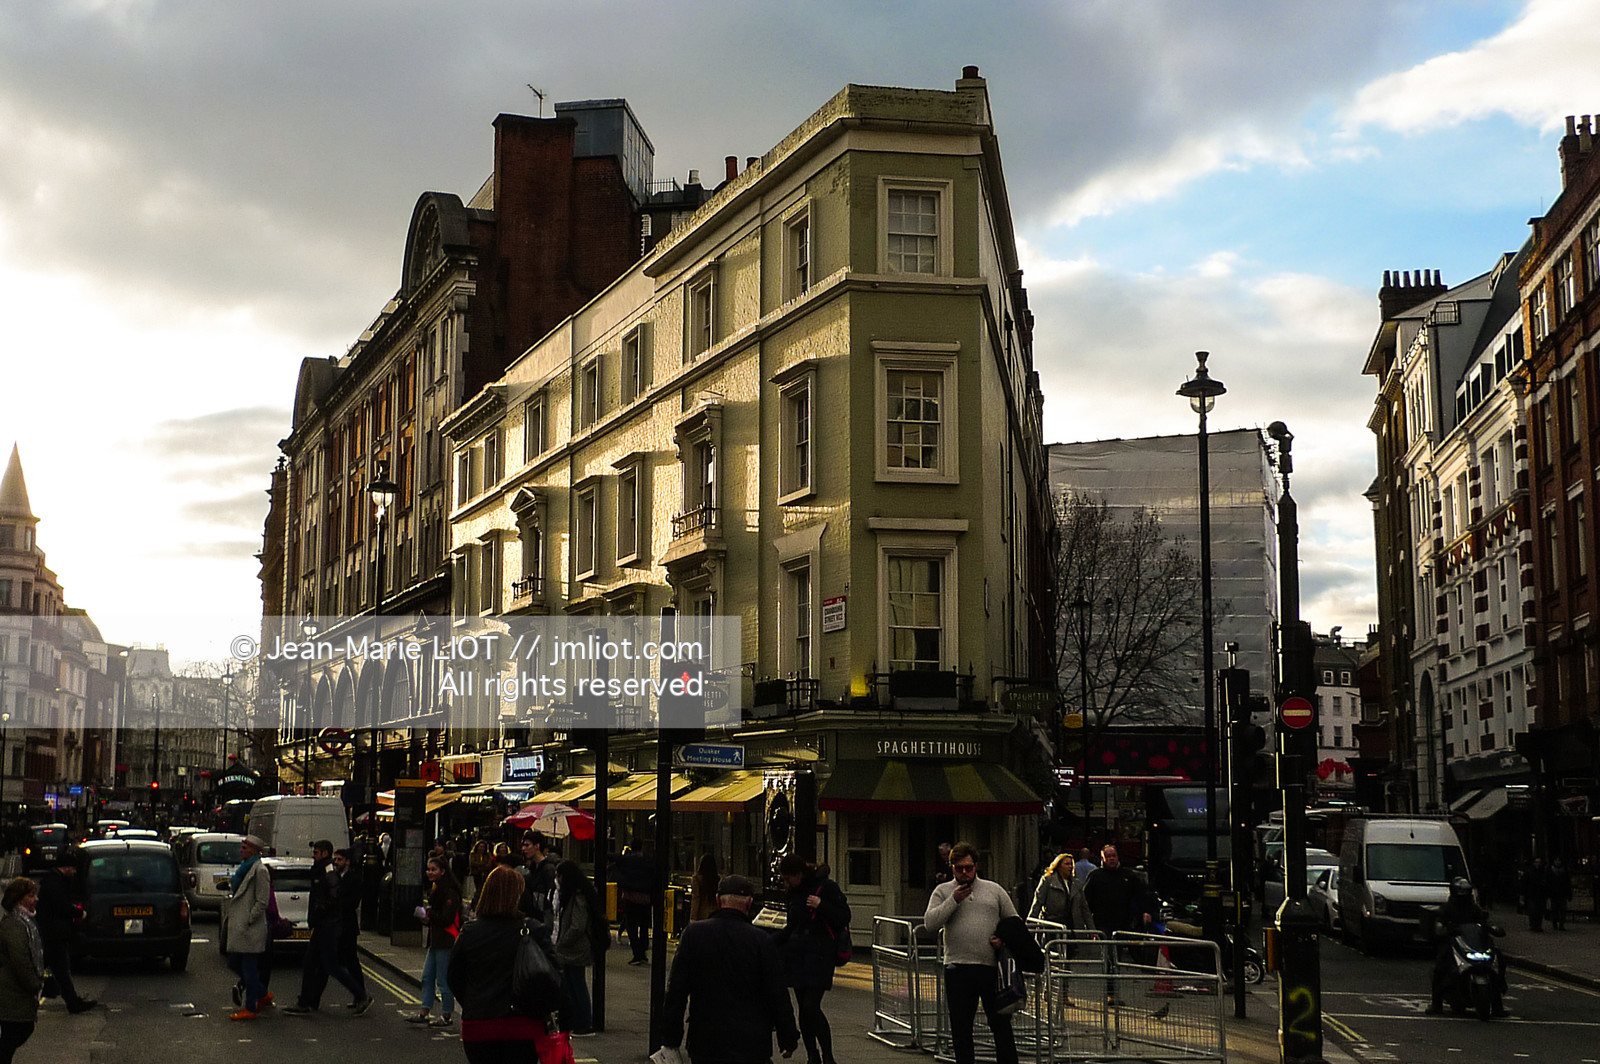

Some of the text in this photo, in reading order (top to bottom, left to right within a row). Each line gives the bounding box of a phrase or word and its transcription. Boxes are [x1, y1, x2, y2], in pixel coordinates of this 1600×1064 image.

[877, 740, 982, 756] SPAGHETTIHOUSE
[686, 755, 732, 764] Meeting House
[1289, 987, 1316, 1040] 2
